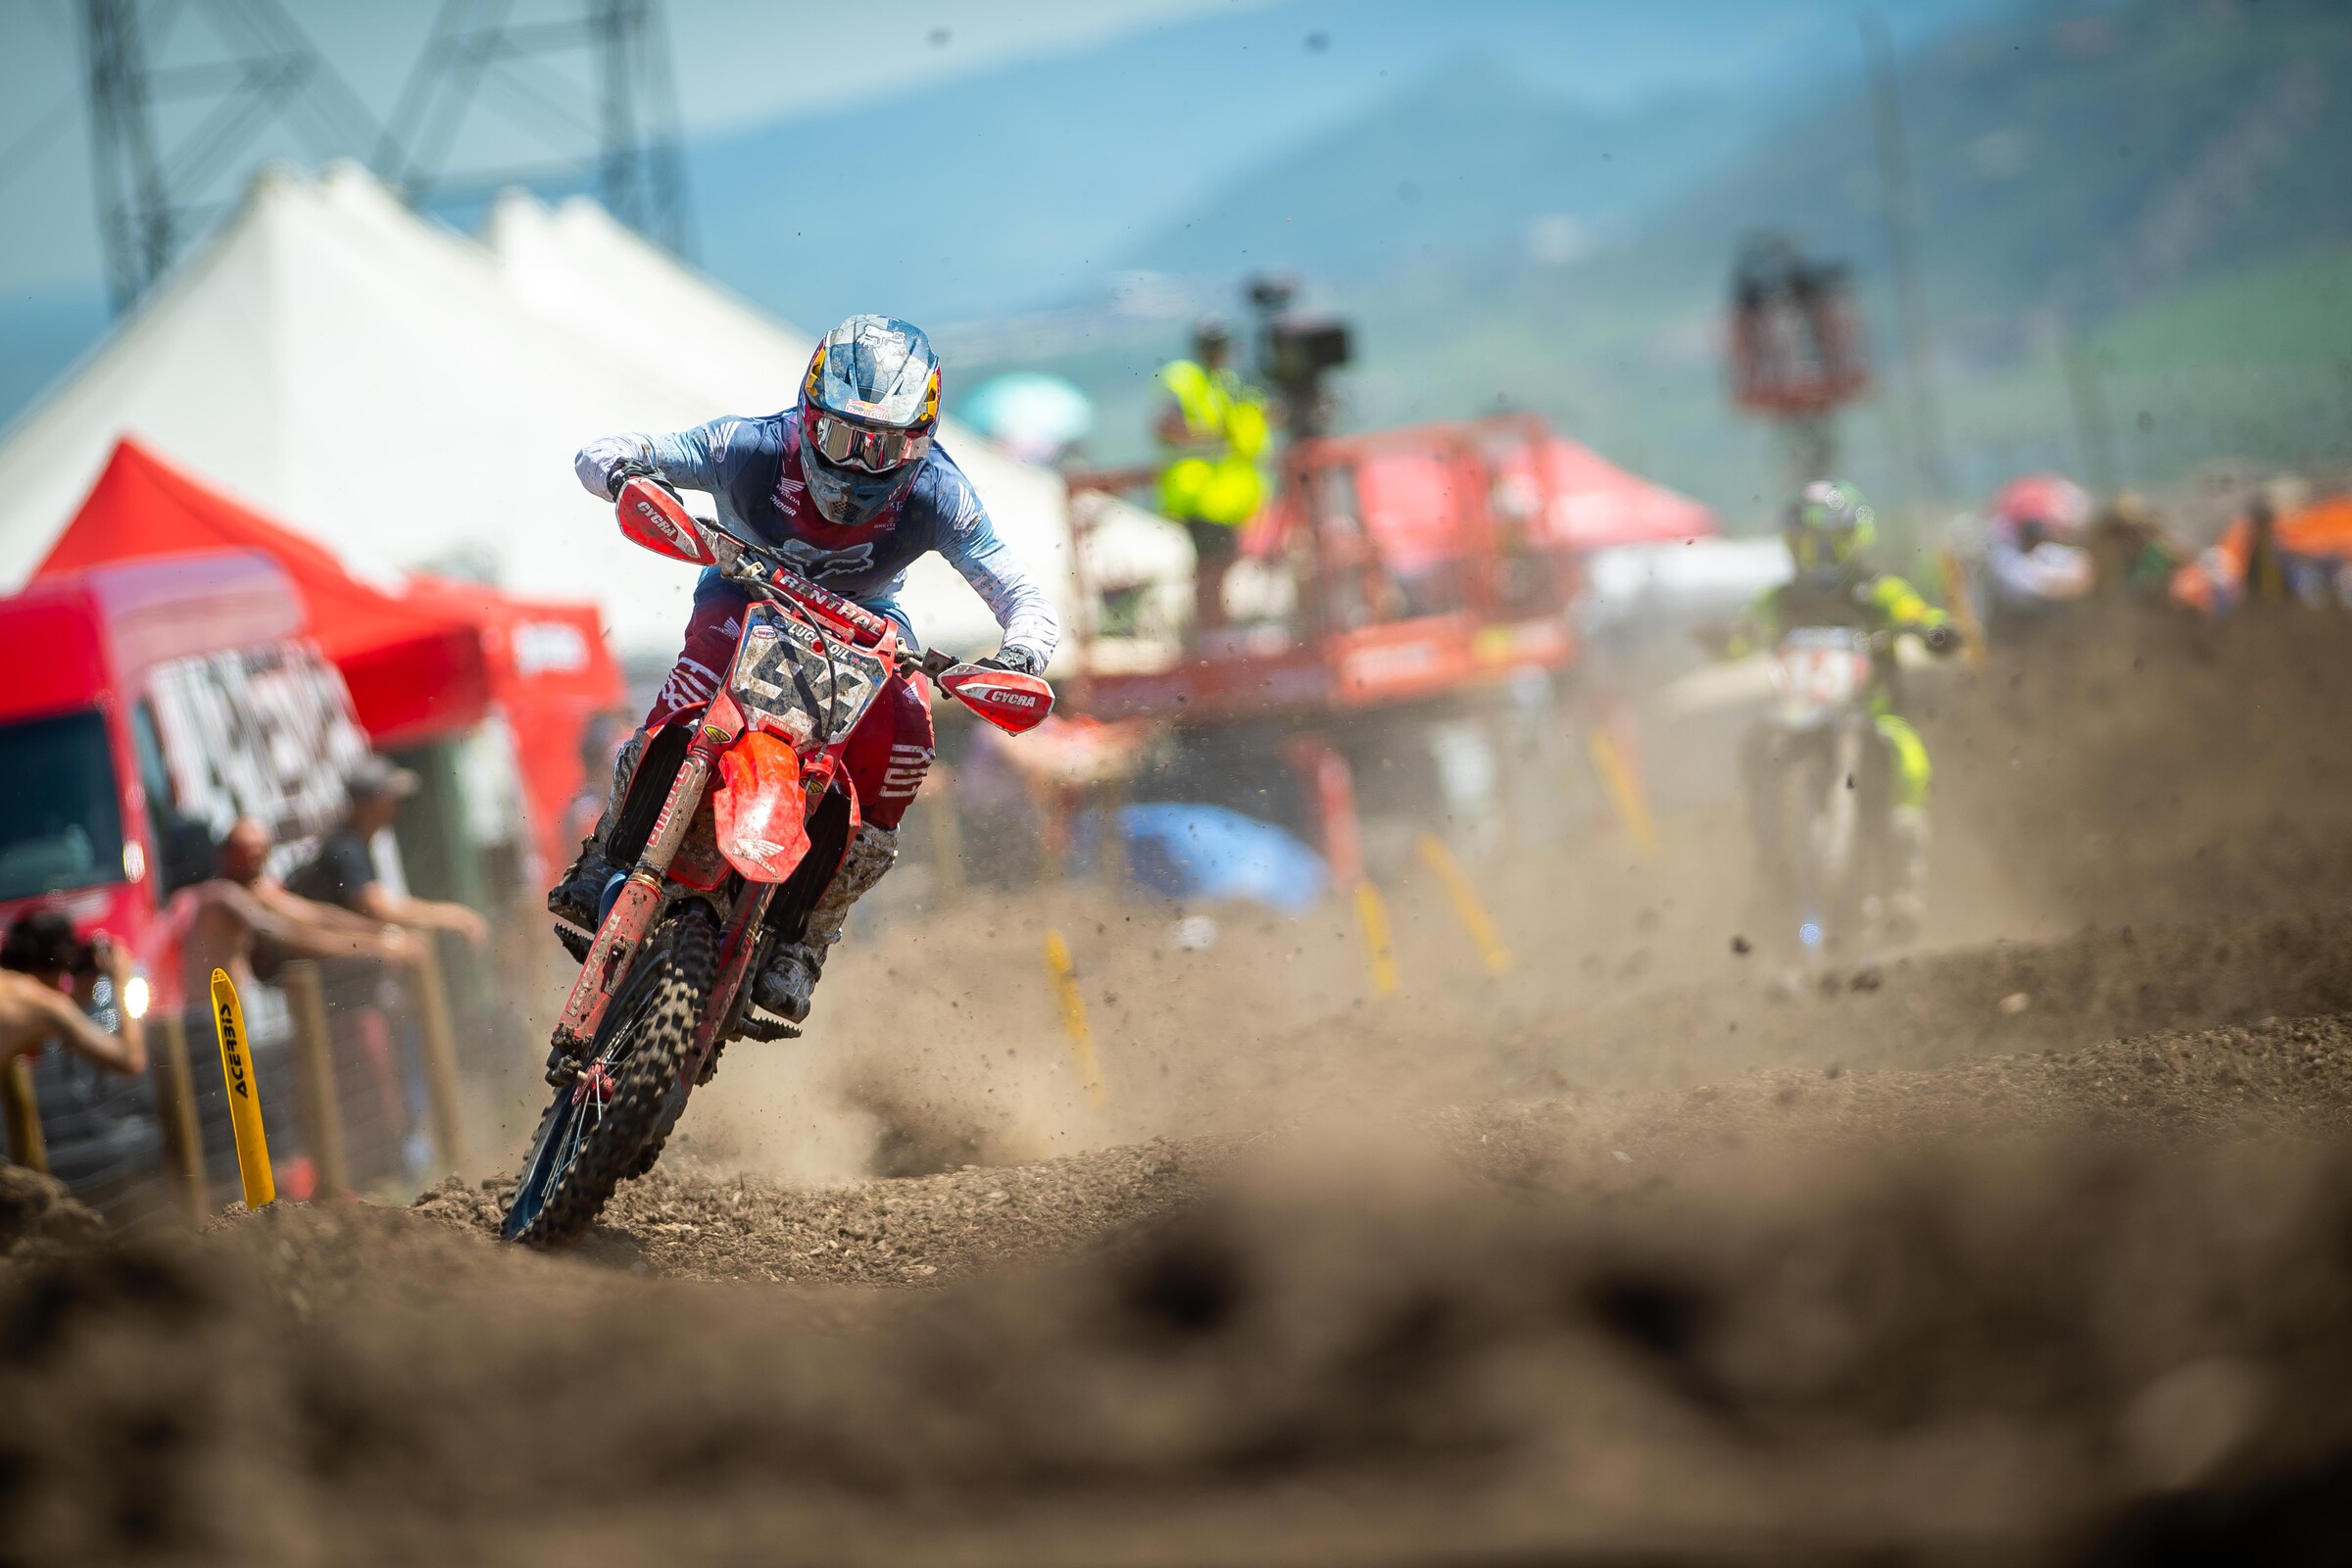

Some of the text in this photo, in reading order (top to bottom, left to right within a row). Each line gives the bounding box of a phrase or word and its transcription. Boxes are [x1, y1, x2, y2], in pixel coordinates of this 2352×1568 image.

[637, 501, 676, 537] CYCRA
[779, 574, 883, 637] RENTHAL
[787, 623, 830, 647] LUC
[830, 644, 849, 661] OIL
[991, 691, 1037, 708] CYCRA
[764, 715, 797, 736] HON
